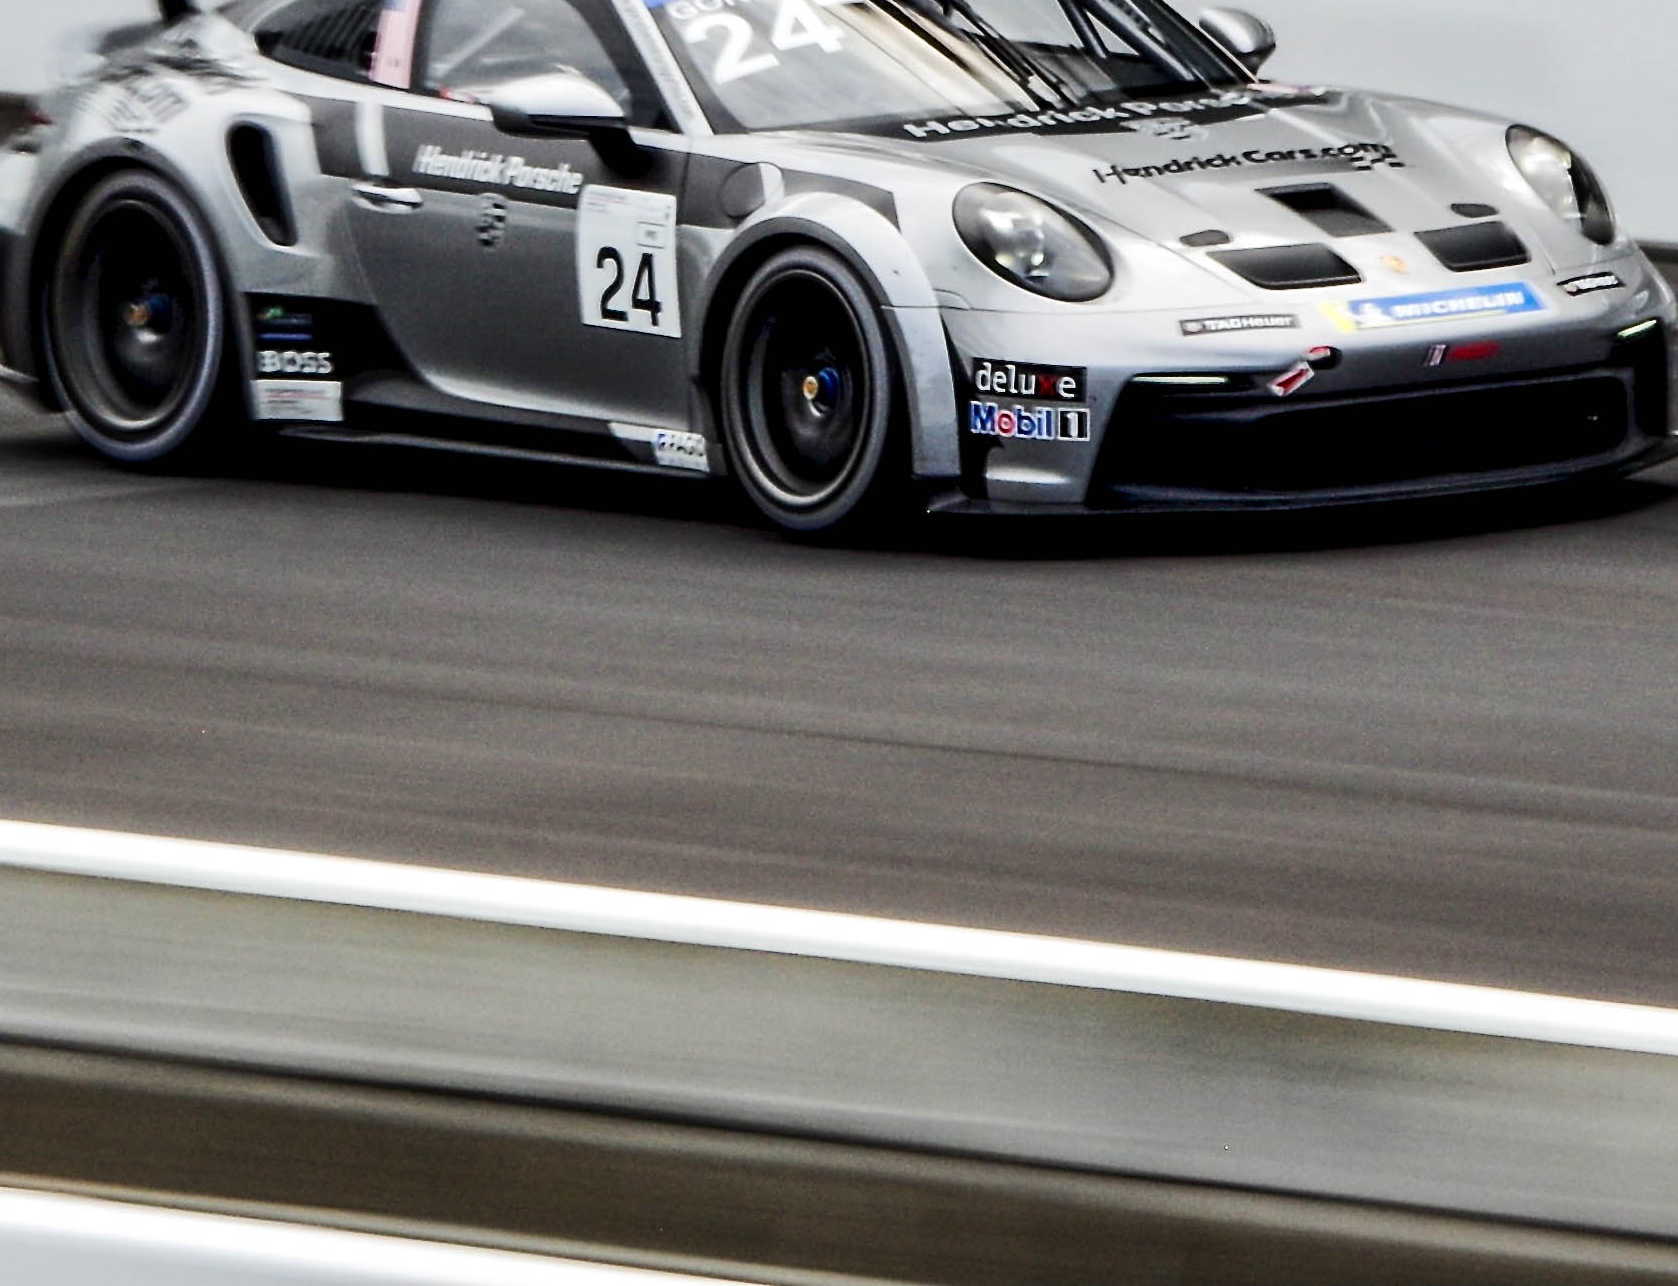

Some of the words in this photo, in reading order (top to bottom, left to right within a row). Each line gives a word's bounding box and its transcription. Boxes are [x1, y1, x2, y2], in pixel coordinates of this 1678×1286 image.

[597, 246, 661, 327] 24
[257, 350, 333, 374] BOSS
[975, 362, 1077, 398] deluxe
[968, 401, 1056, 440] Mobil
